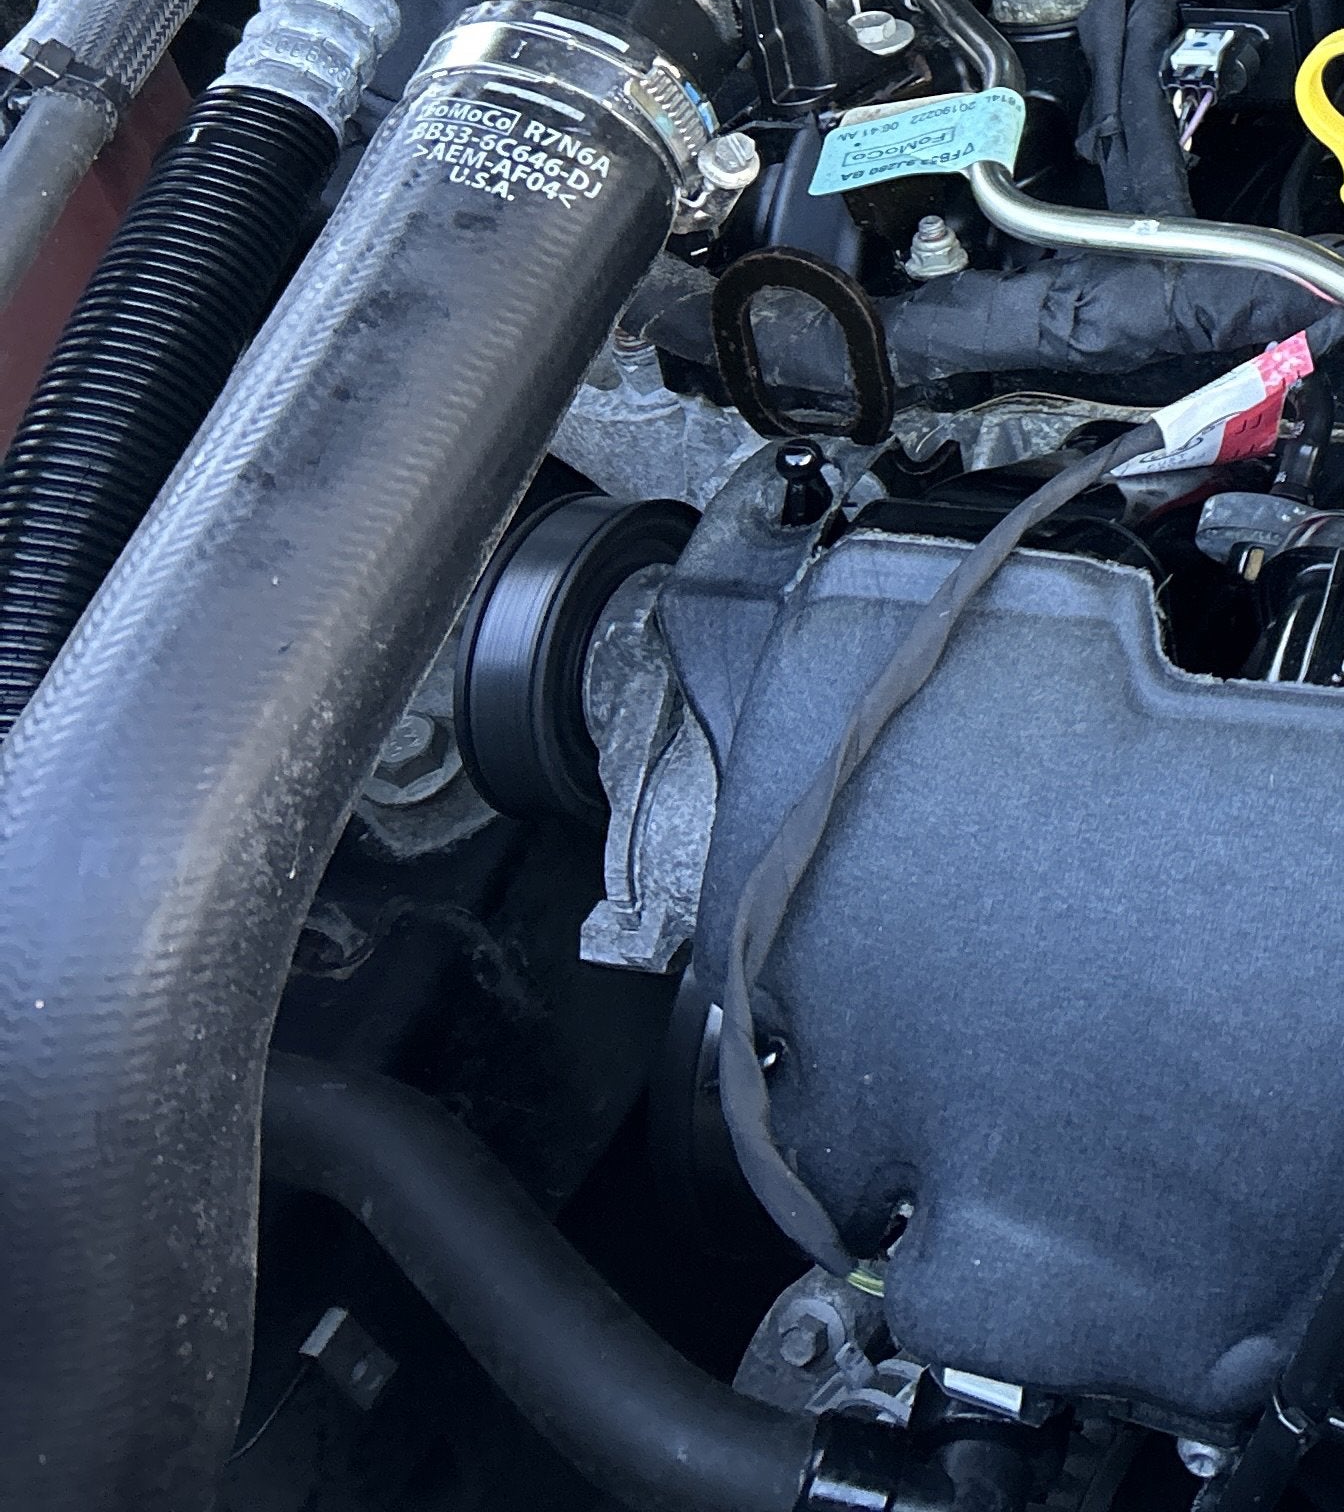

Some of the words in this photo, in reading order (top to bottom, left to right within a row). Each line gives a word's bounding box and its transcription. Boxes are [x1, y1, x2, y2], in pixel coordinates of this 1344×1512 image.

[421, 100, 512, 131] FoMoCo
[523, 119, 612, 179] R7N6A
[851, 132, 948, 161] FoMoCo
[411, 142, 578, 210] >AEM-AF04<
[448, 167, 517, 203] U.S.A.
